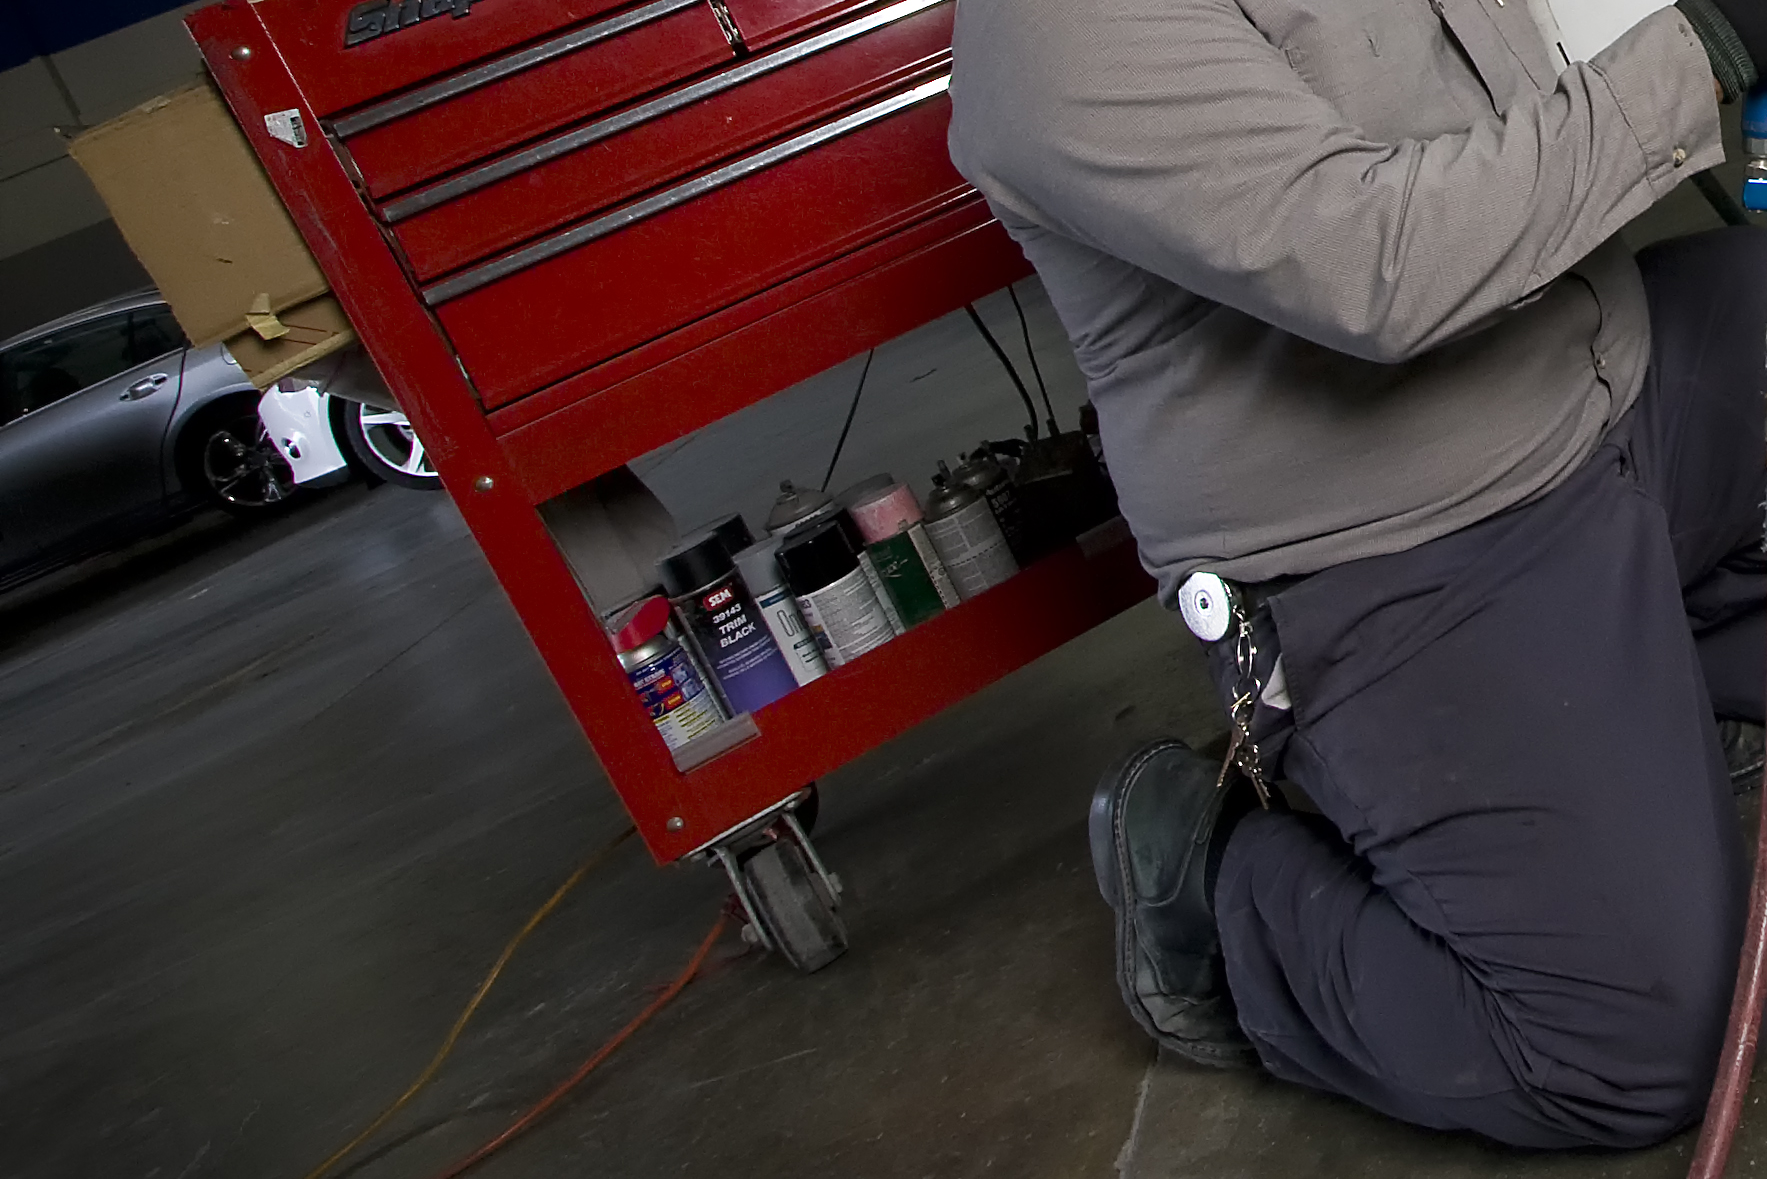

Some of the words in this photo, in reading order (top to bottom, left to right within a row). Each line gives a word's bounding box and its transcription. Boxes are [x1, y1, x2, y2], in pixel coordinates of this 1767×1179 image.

[708, 588, 732, 607] SEM
[718, 614, 748, 635] TRIM
[719, 622, 757, 648] BLACK
